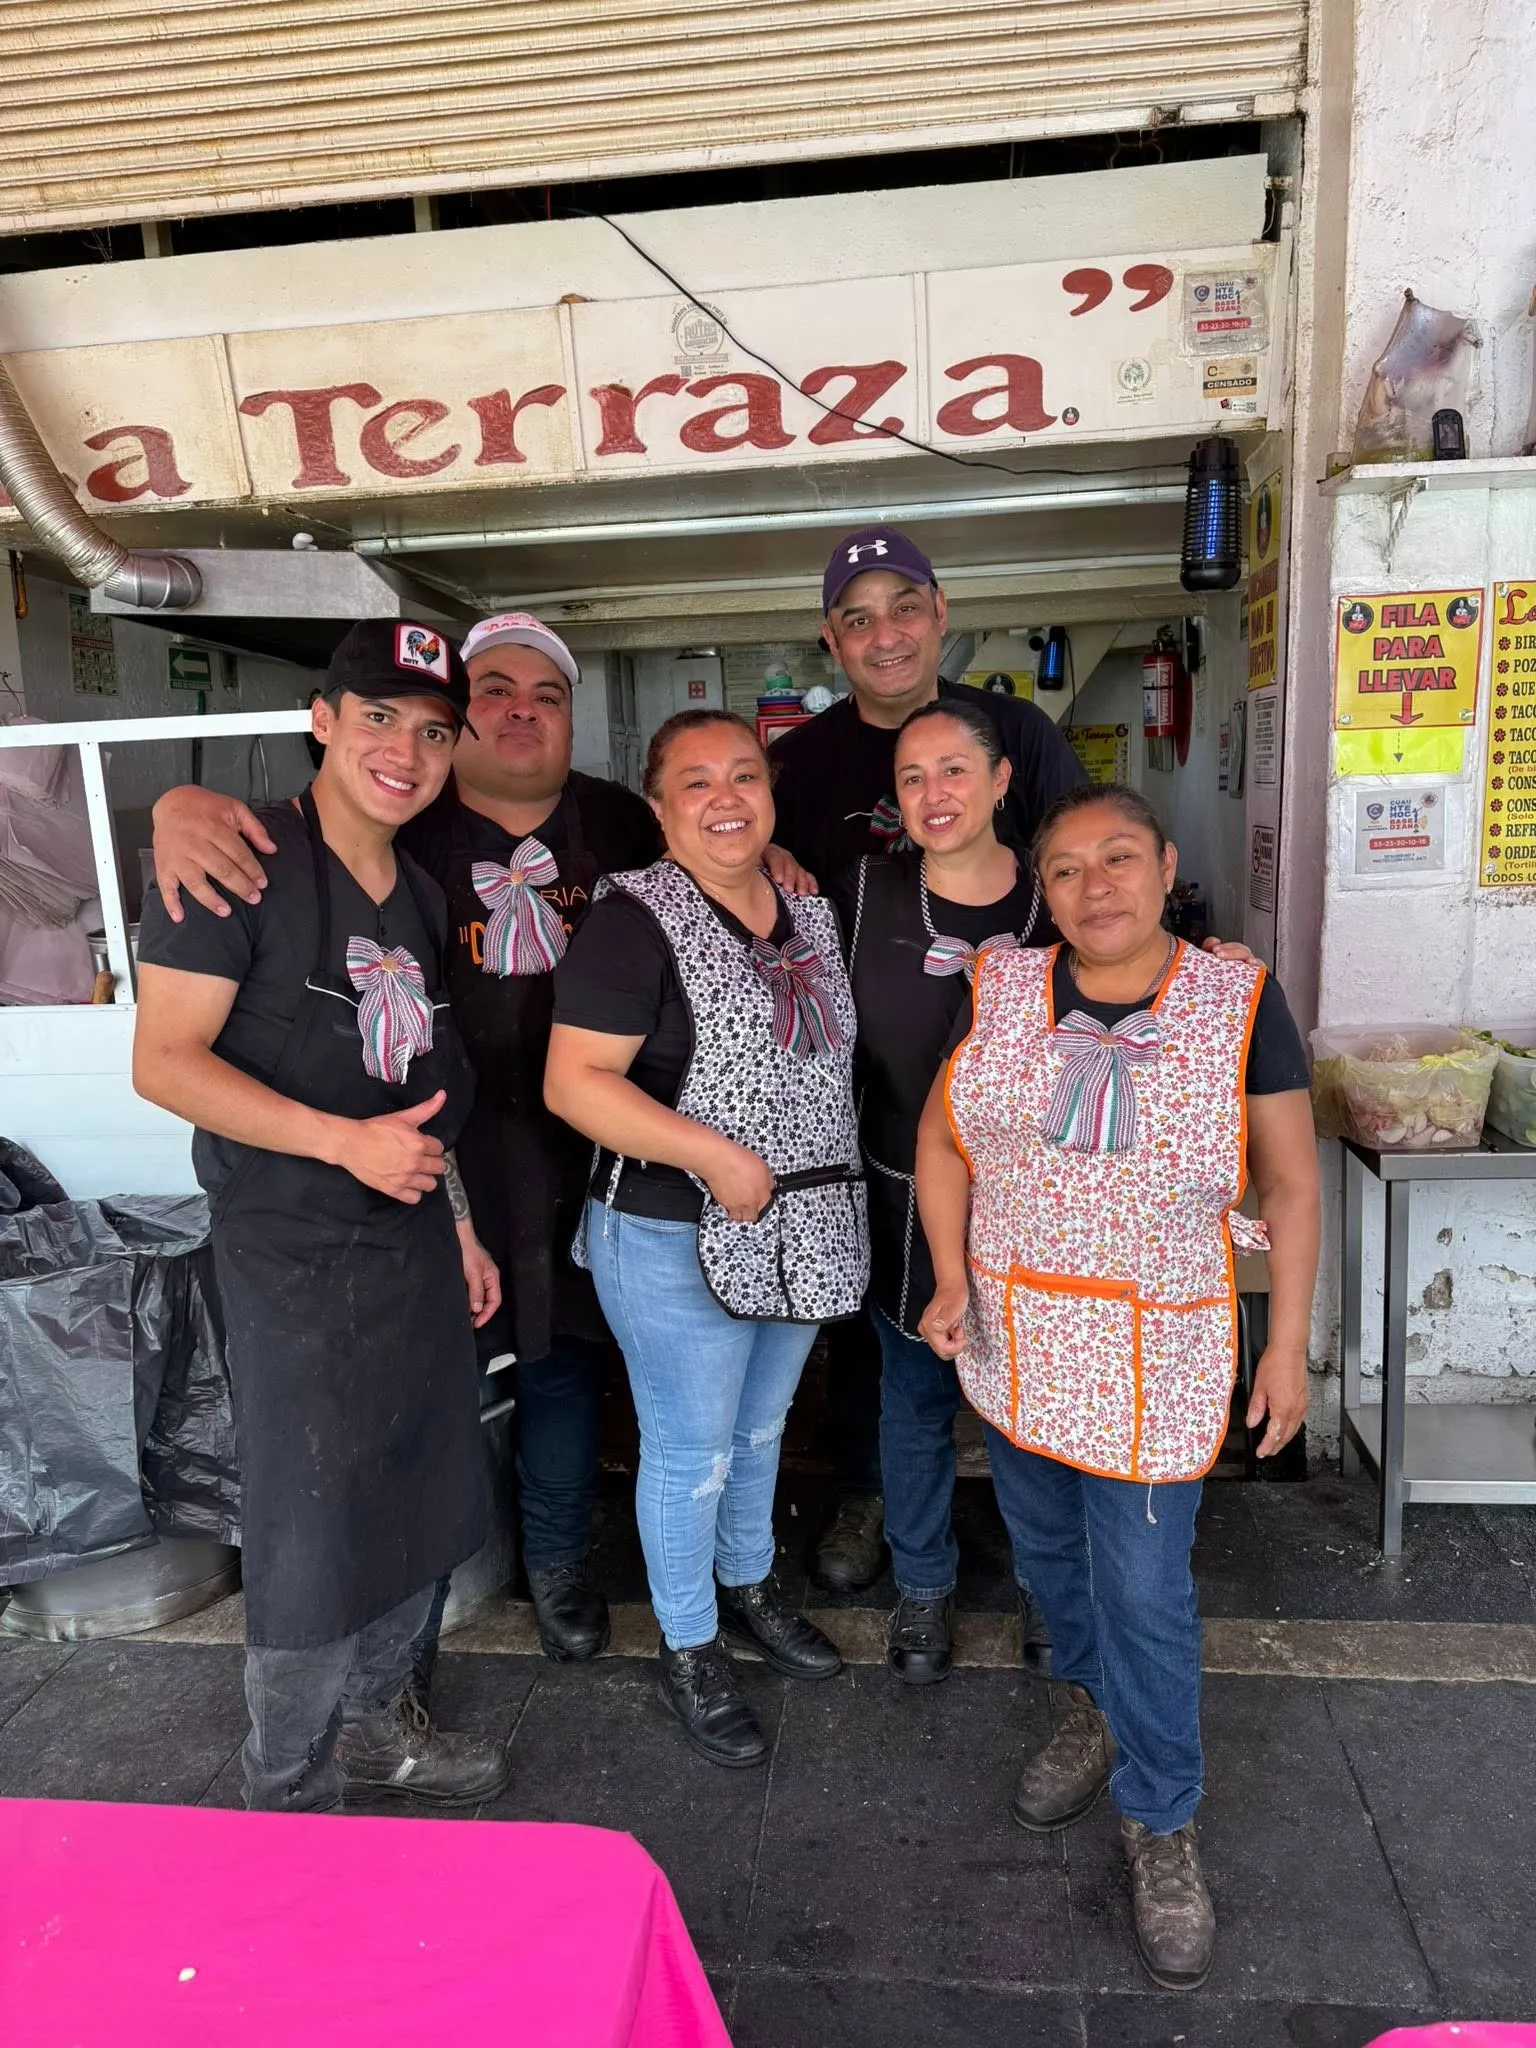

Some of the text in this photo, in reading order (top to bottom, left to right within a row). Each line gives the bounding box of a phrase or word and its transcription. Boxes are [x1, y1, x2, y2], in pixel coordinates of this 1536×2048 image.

[1207, 379, 1252, 389] CENSADO
[1381, 603, 1440, 628] FILA
[1373, 635, 1445, 660] PARA
[1358, 667, 1457, 693] LLEVAR
[540, 886, 587, 906] RIA
